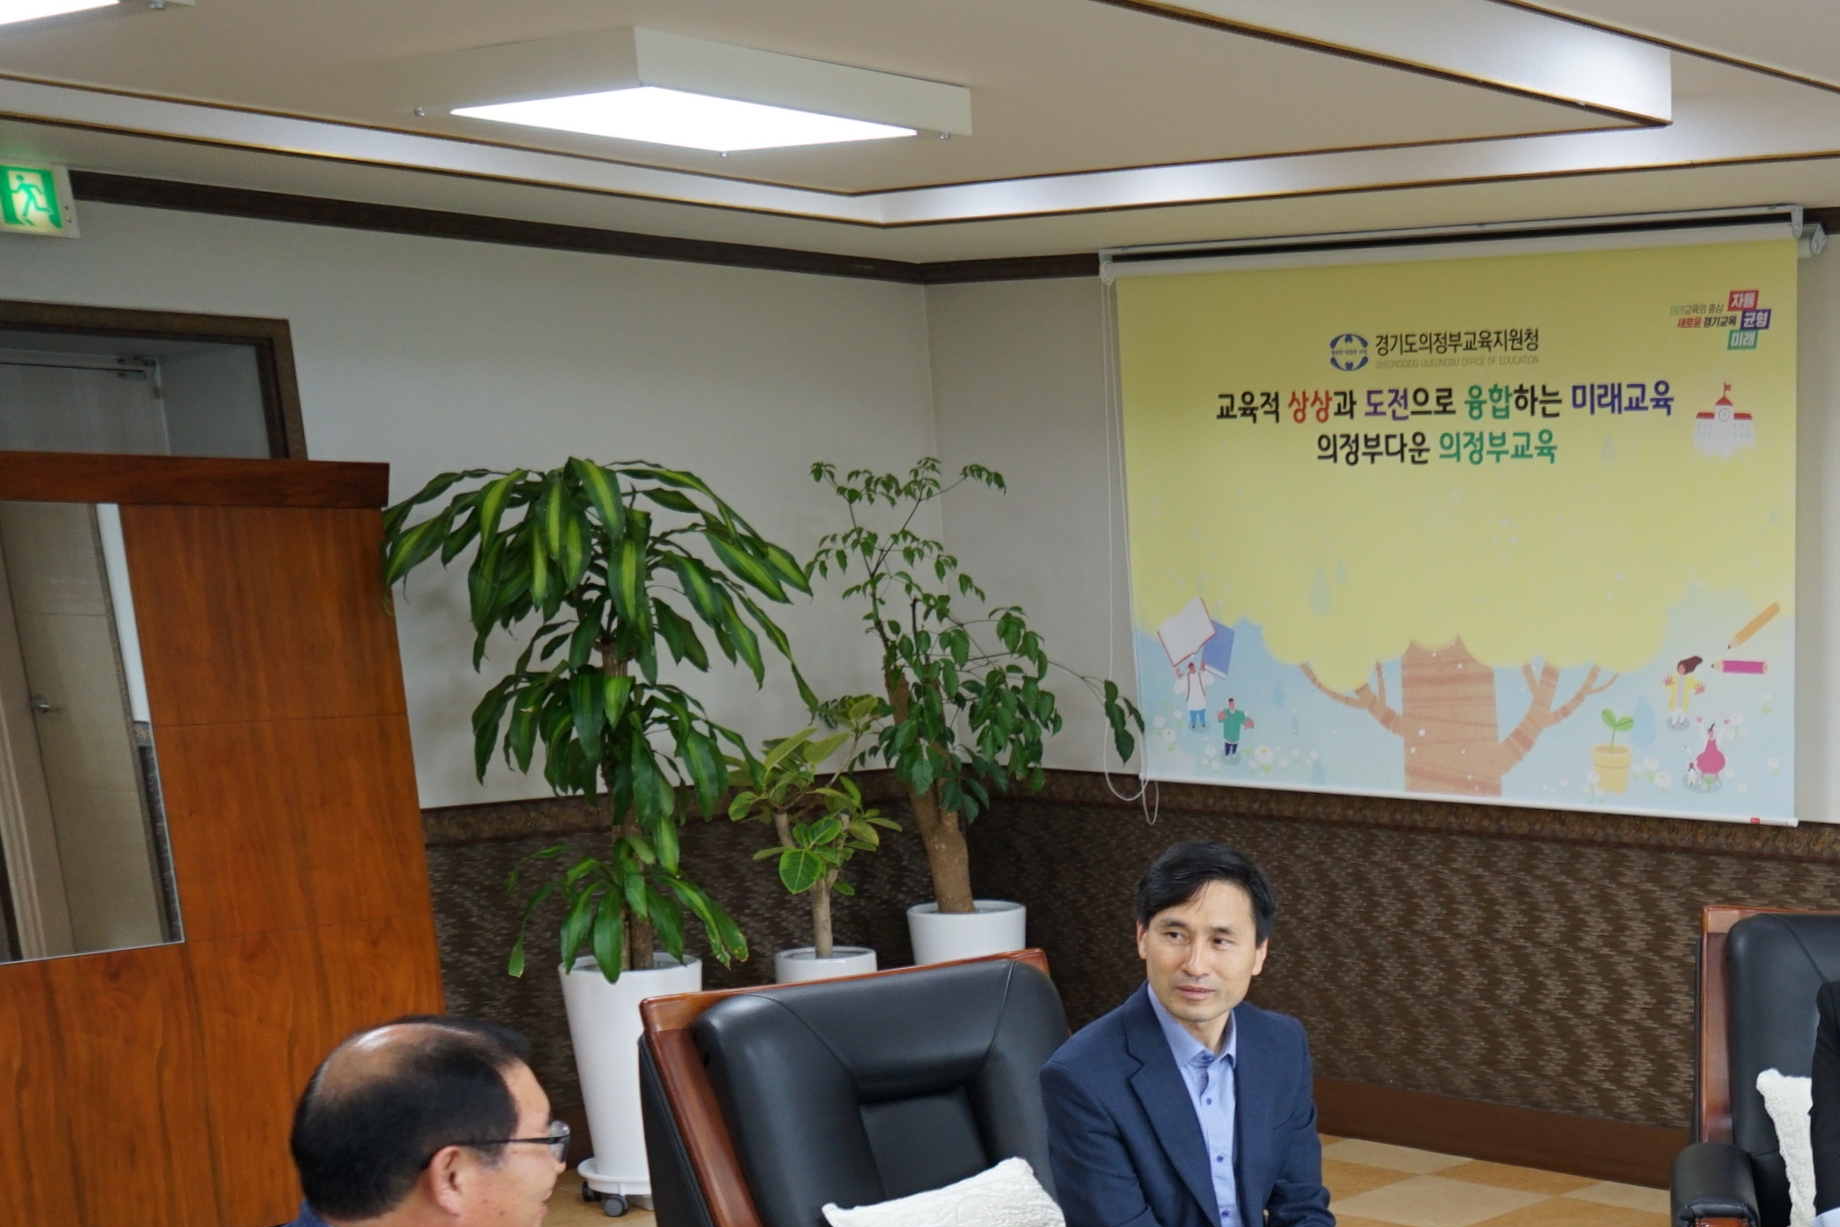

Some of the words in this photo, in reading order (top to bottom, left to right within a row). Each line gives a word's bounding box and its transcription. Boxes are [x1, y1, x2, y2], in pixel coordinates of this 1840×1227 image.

[1731, 292, 1756, 308] 자율
[1677, 317, 1702, 328] 새로운
[1703, 316, 1737, 327] 경기교육
[1744, 311, 1768, 328] 균형
[1375, 327, 1540, 356] 경기도의정부교육지원청
[1730, 331, 1756, 347] 미래
[1462, 356, 1486, 367] OFFICE
[1488, 356, 1496, 366] OF
[1499, 354, 1540, 366] EDUCATION
[1216, 390, 1280, 424] 교육적
[1287, 389, 1357, 424] 상상과
[1364, 387, 1456, 422] 도전으로
[1464, 383, 1562, 420] 융합하는
[1571, 380, 1675, 417] 미래교육
[1317, 431, 1430, 466] 의정부다운
[1438, 428, 1558, 466] 의정부교육
